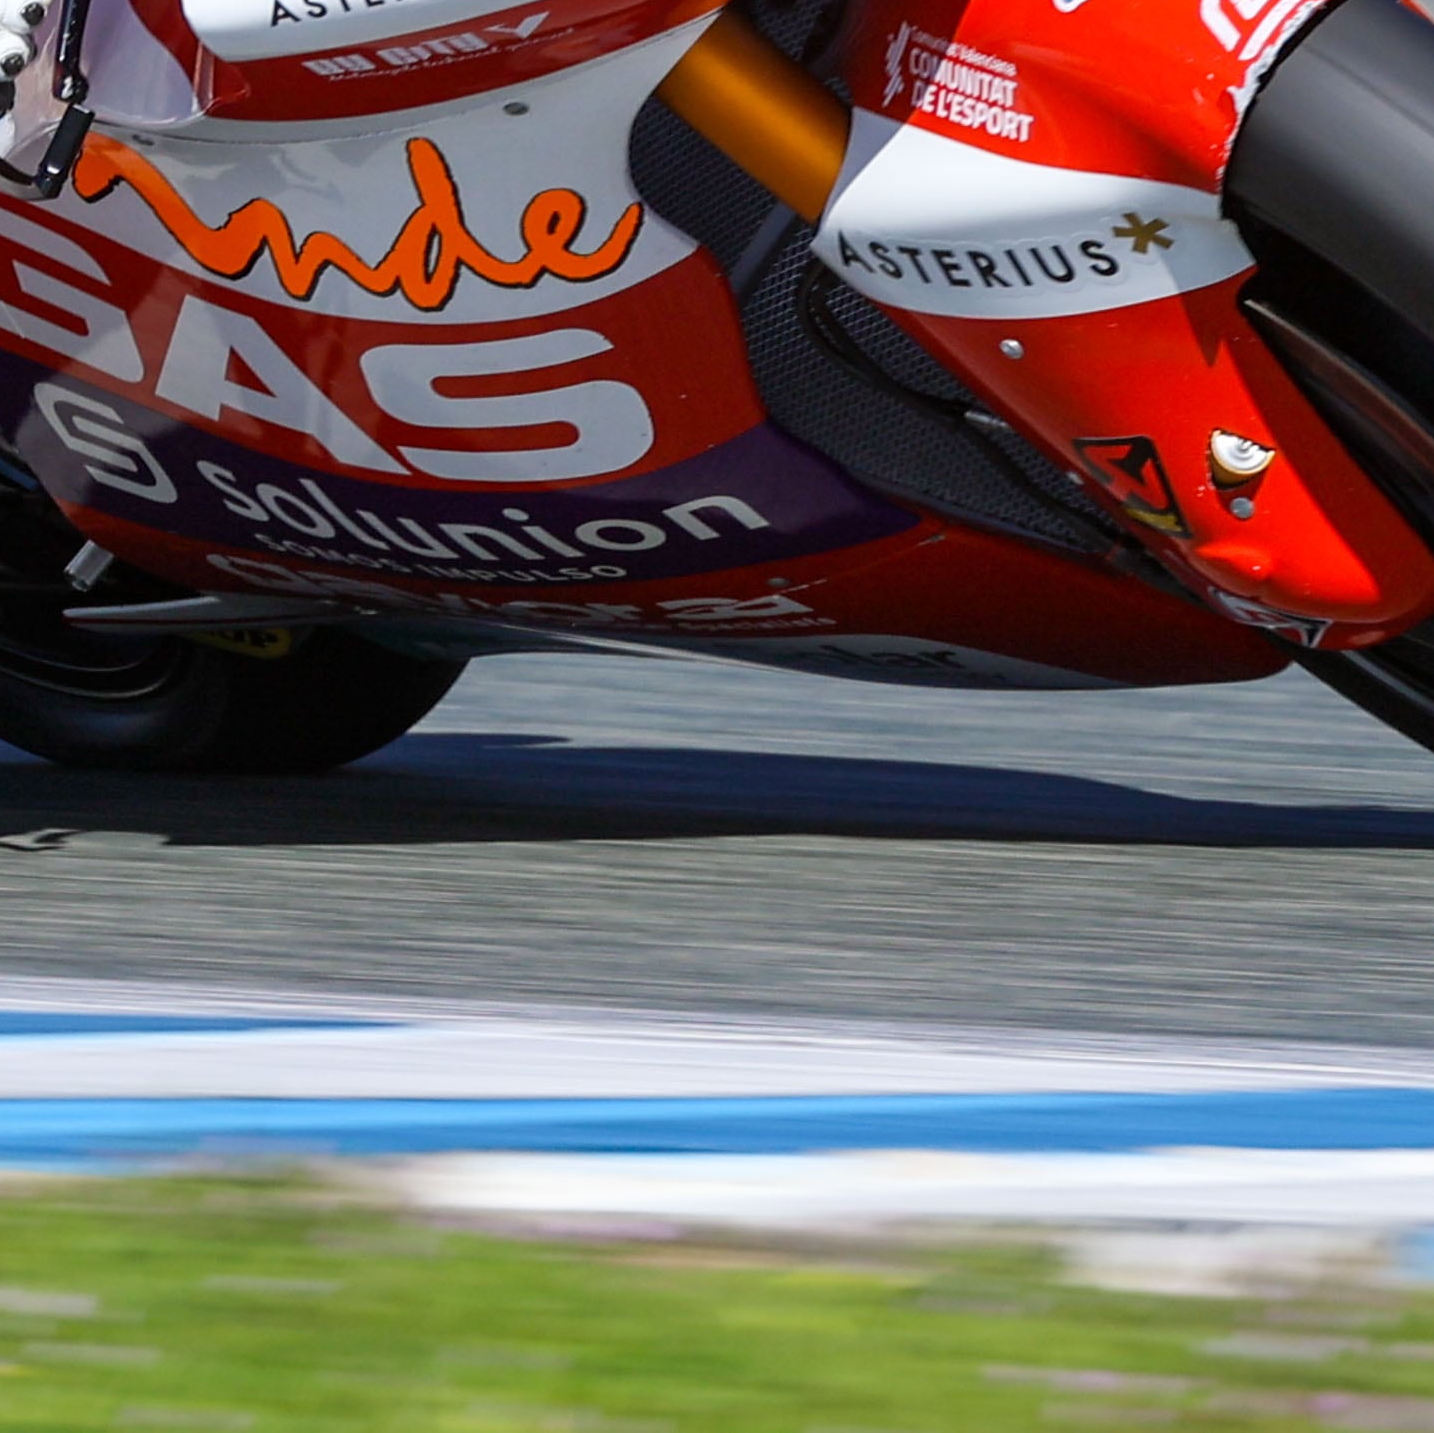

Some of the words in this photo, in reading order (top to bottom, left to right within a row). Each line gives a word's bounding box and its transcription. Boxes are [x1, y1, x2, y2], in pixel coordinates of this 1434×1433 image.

[908, 46, 1018, 108] COMUNITAT
[910, 79, 939, 113] DE
[935, 88, 1035, 143] L'ESPORT
[837, 230, 1122, 288] ASTERIUS
[194, 458, 771, 564] solunion
[413, 564, 629, 584] IMPULSO
